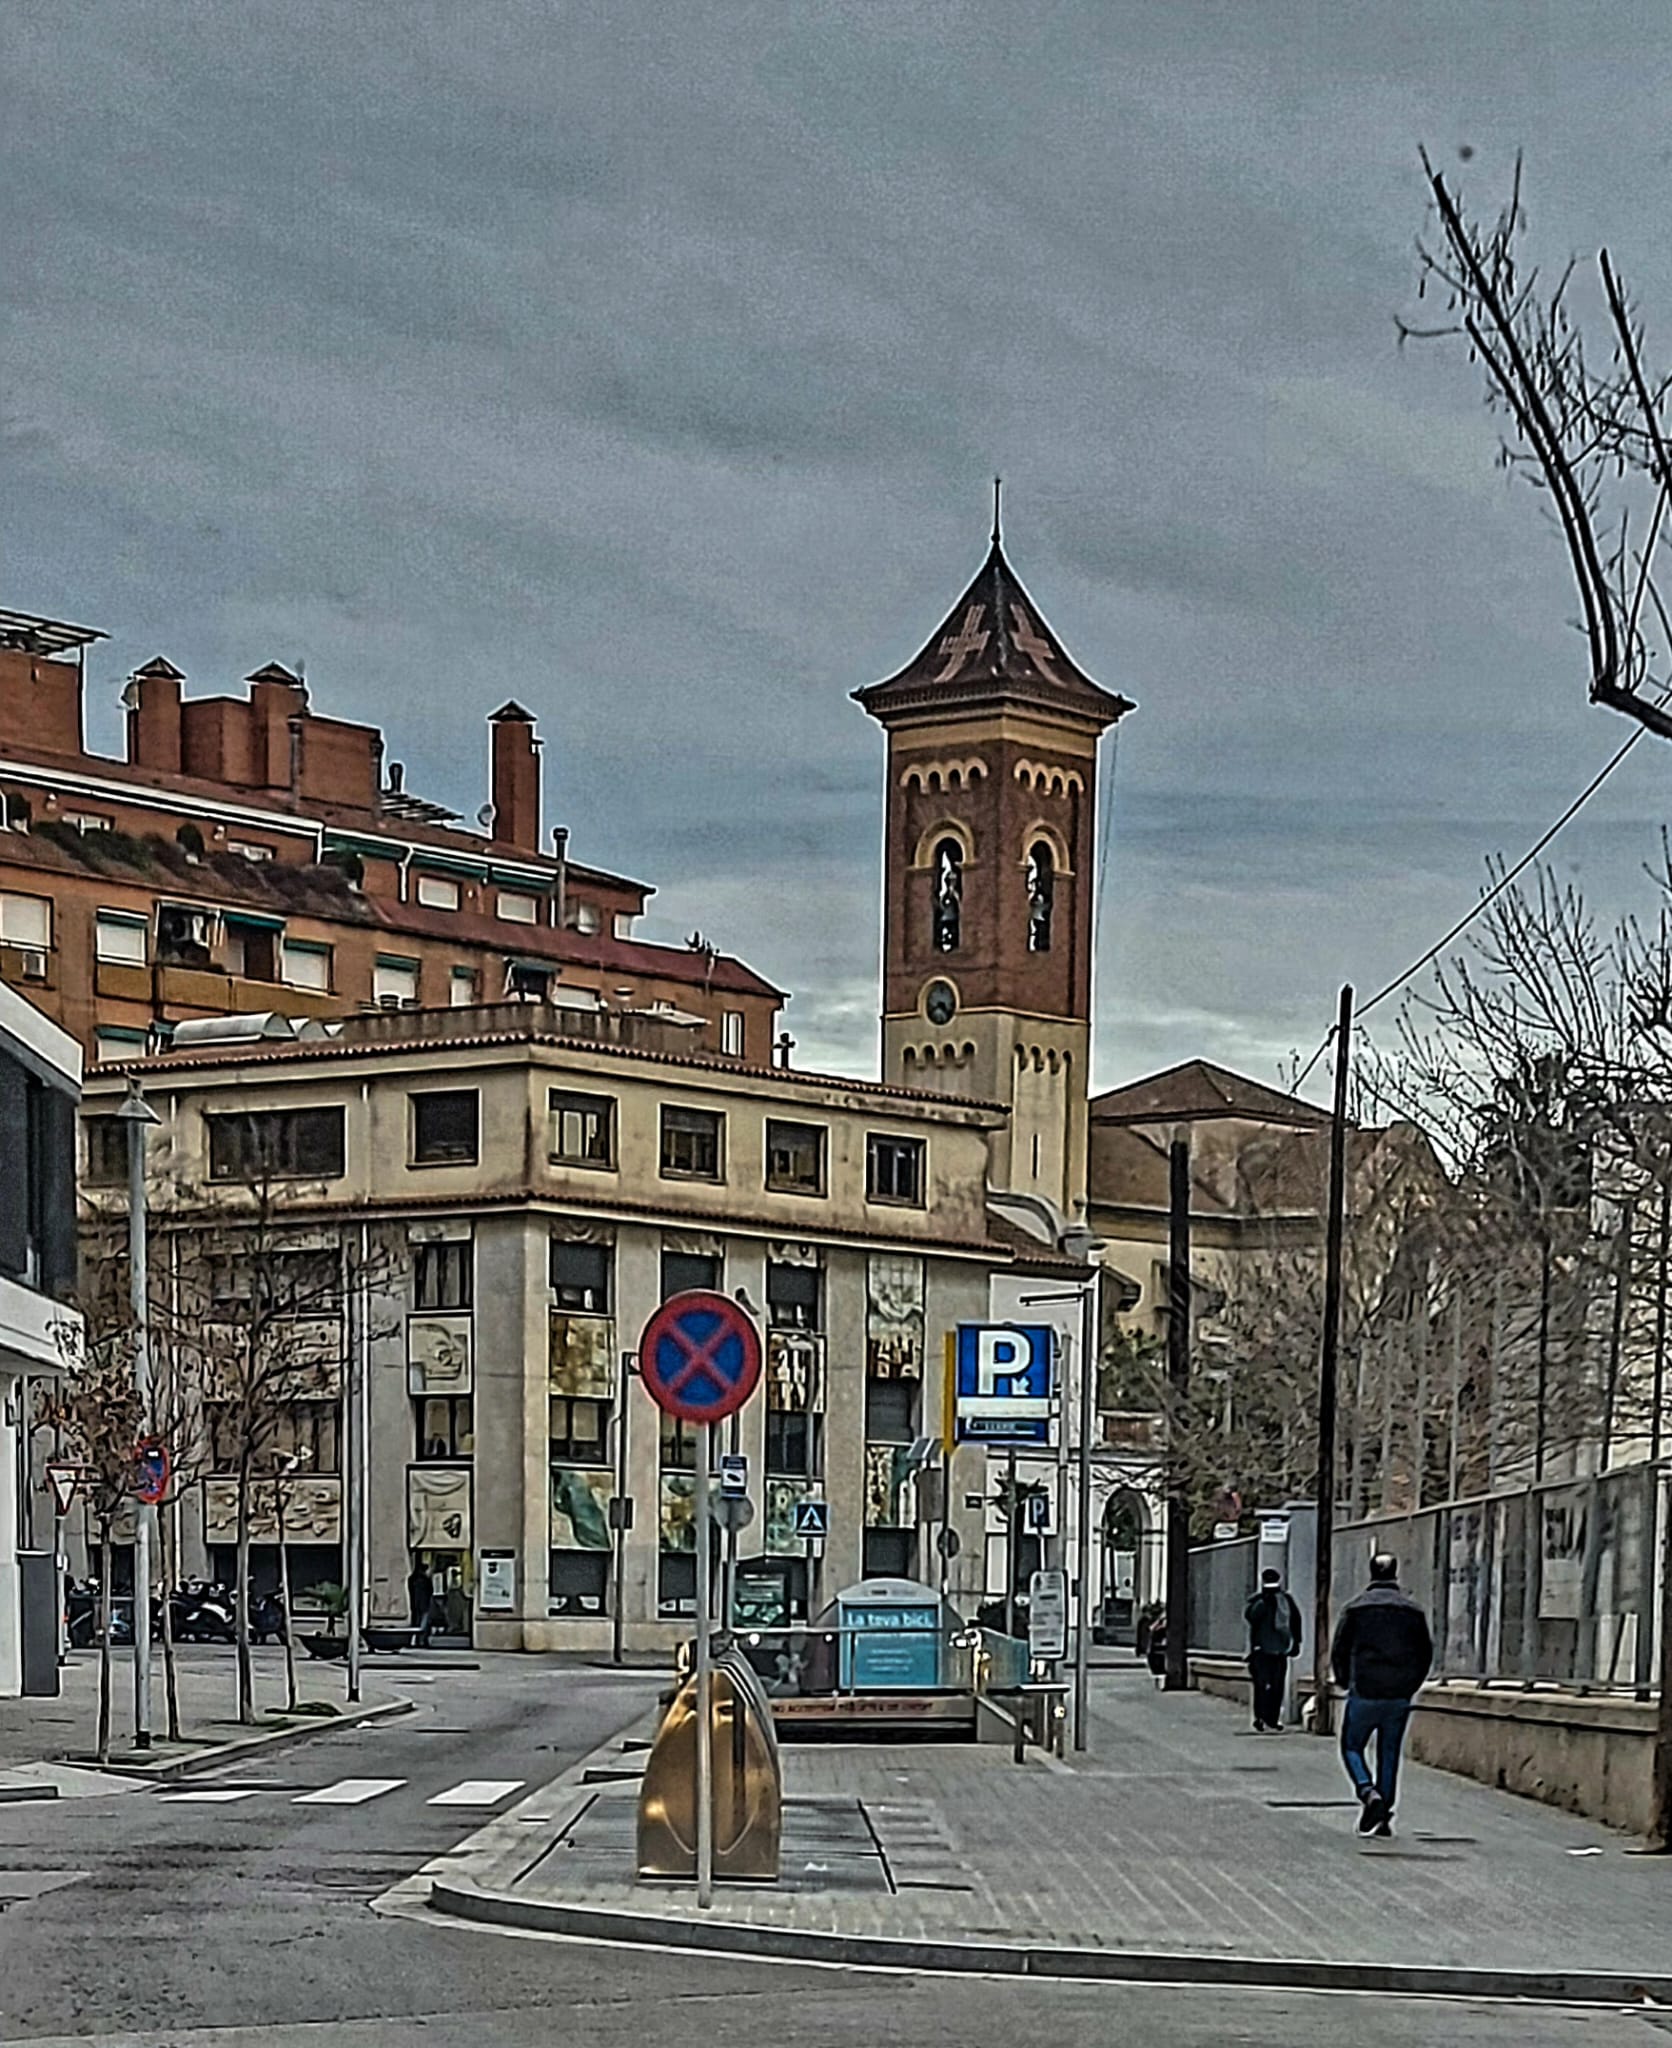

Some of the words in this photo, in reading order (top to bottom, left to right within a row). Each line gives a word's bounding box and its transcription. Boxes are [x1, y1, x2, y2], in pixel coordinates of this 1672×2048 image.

[978, 1330, 1031, 1395] P
[1033, 1498, 1045, 1523] P
[847, 1611, 865, 1627] La
